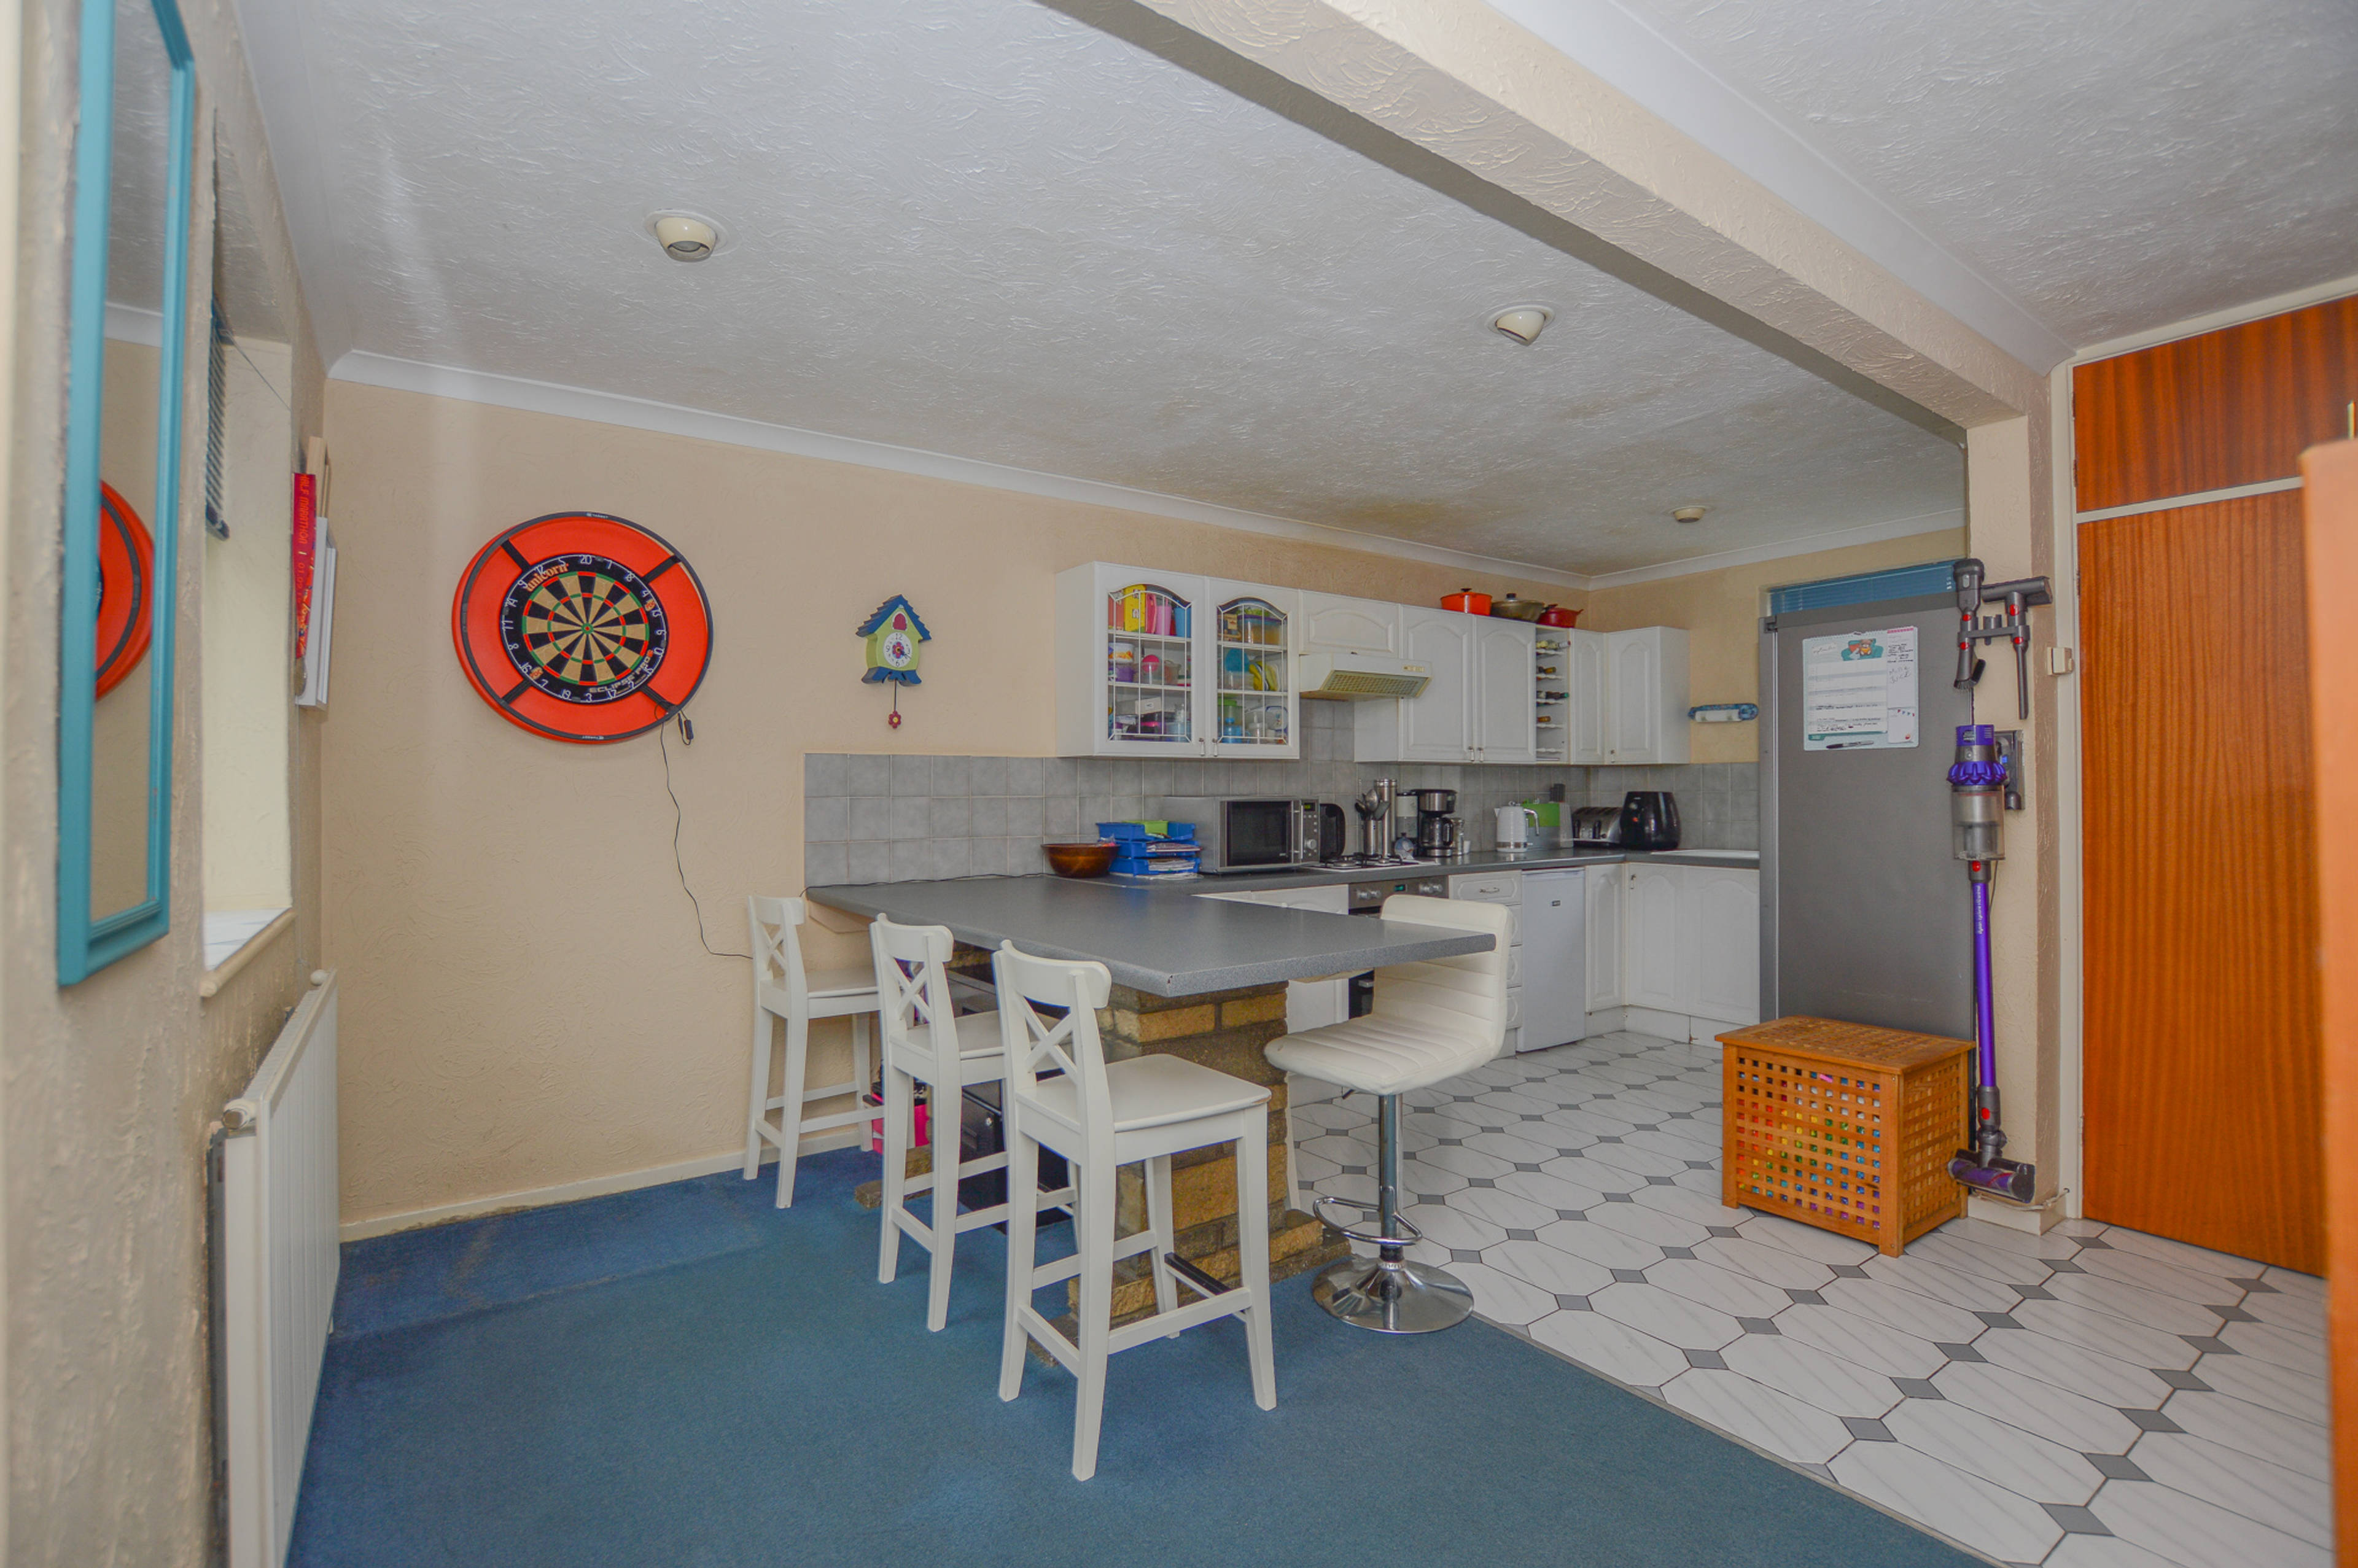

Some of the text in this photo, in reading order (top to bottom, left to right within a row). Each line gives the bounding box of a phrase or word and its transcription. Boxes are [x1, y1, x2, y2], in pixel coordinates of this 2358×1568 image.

[300, 474, 309, 495] HALF
[299, 496, 309, 545] MARATHON
[580, 554, 592, 564] 20
